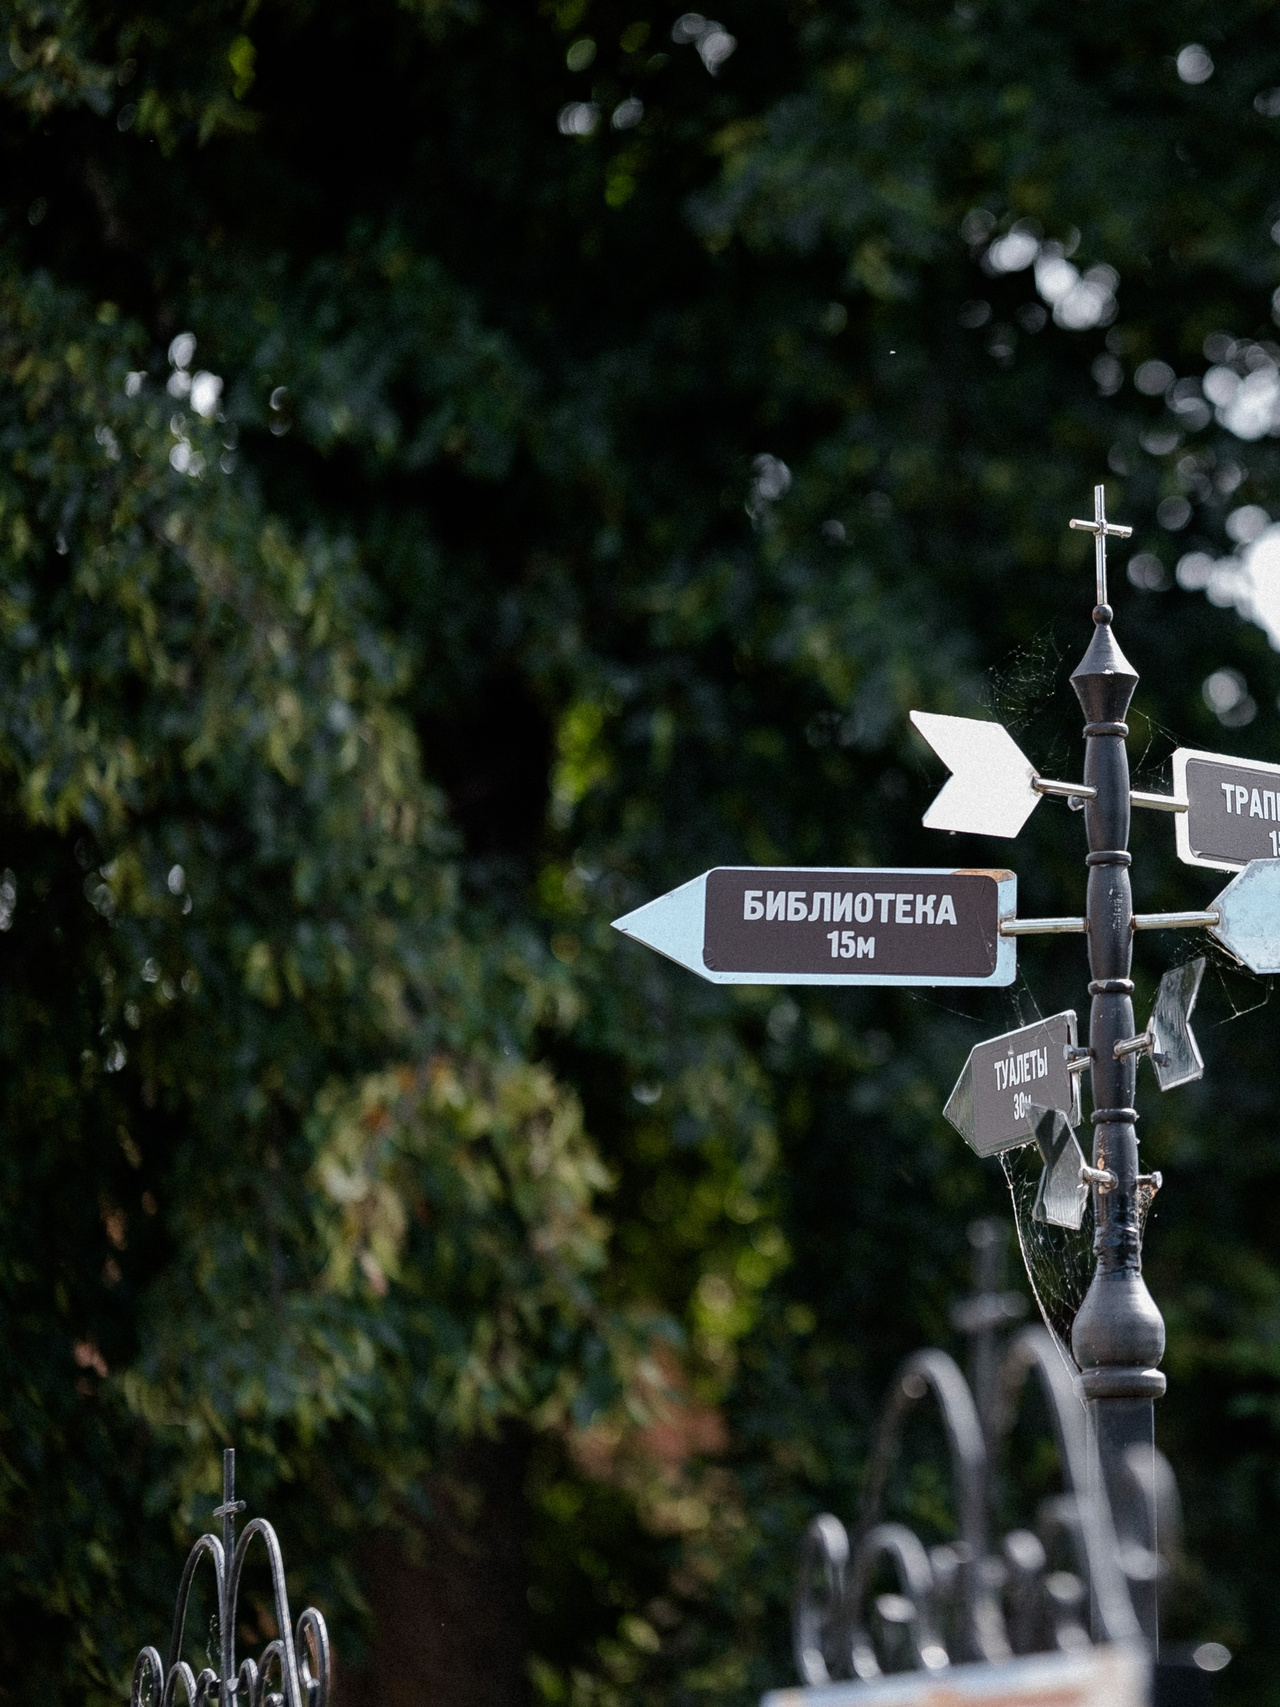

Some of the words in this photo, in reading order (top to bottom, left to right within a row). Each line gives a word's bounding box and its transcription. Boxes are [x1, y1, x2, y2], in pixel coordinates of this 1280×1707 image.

[743, 890, 958, 925] БИБЛИОТЕКА
[827, 930, 876, 959] 15м
[994, 1046, 1048, 1091] ТУАЛЕТЫ
